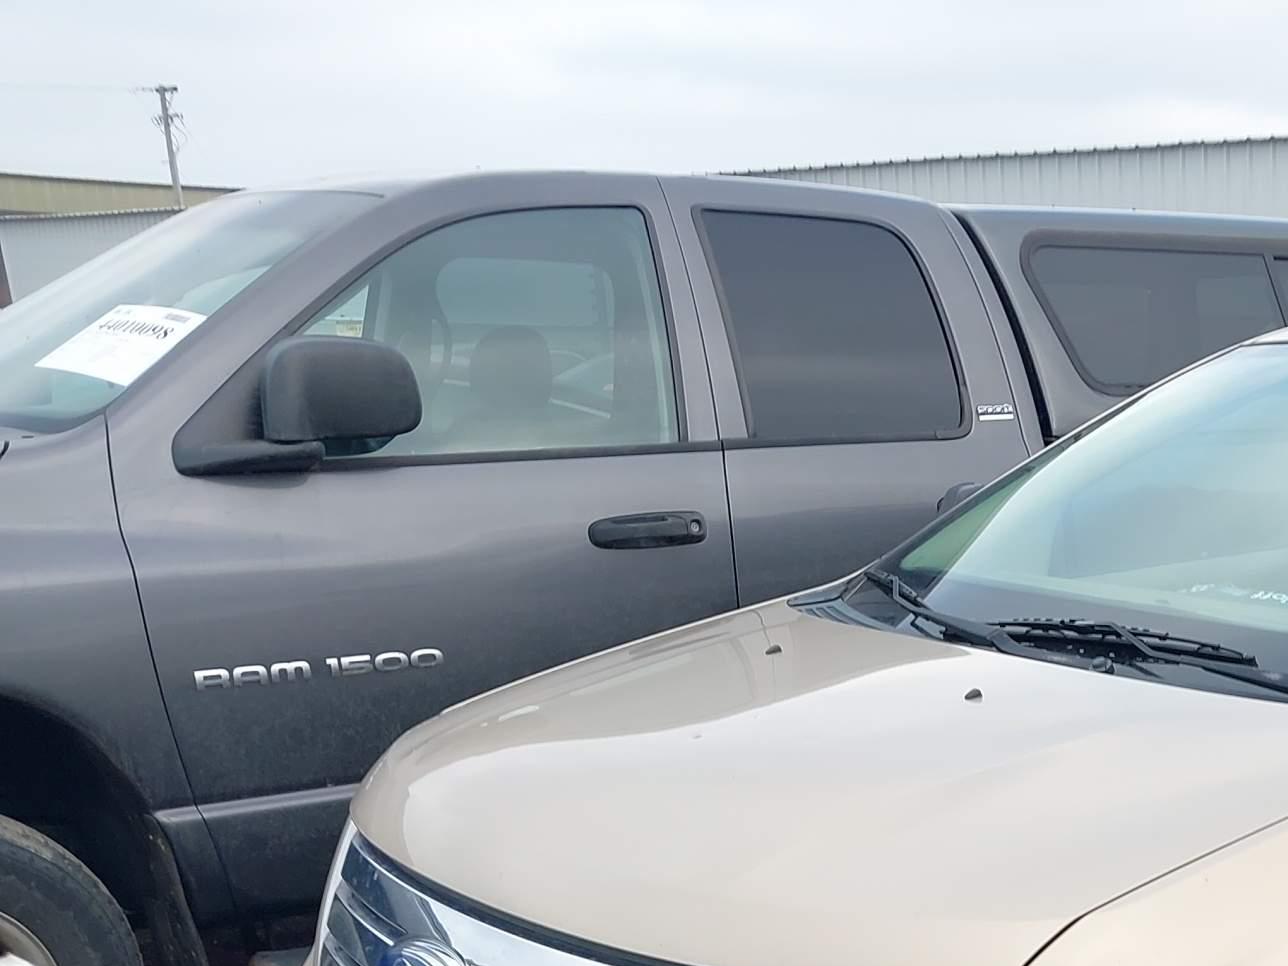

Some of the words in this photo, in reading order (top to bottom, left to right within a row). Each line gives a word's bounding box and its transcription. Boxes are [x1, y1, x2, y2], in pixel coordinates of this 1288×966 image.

[100, 318, 176, 340] 44010098
[193, 660, 313, 691] RAM
[325, 647, 444, 677] 1500
